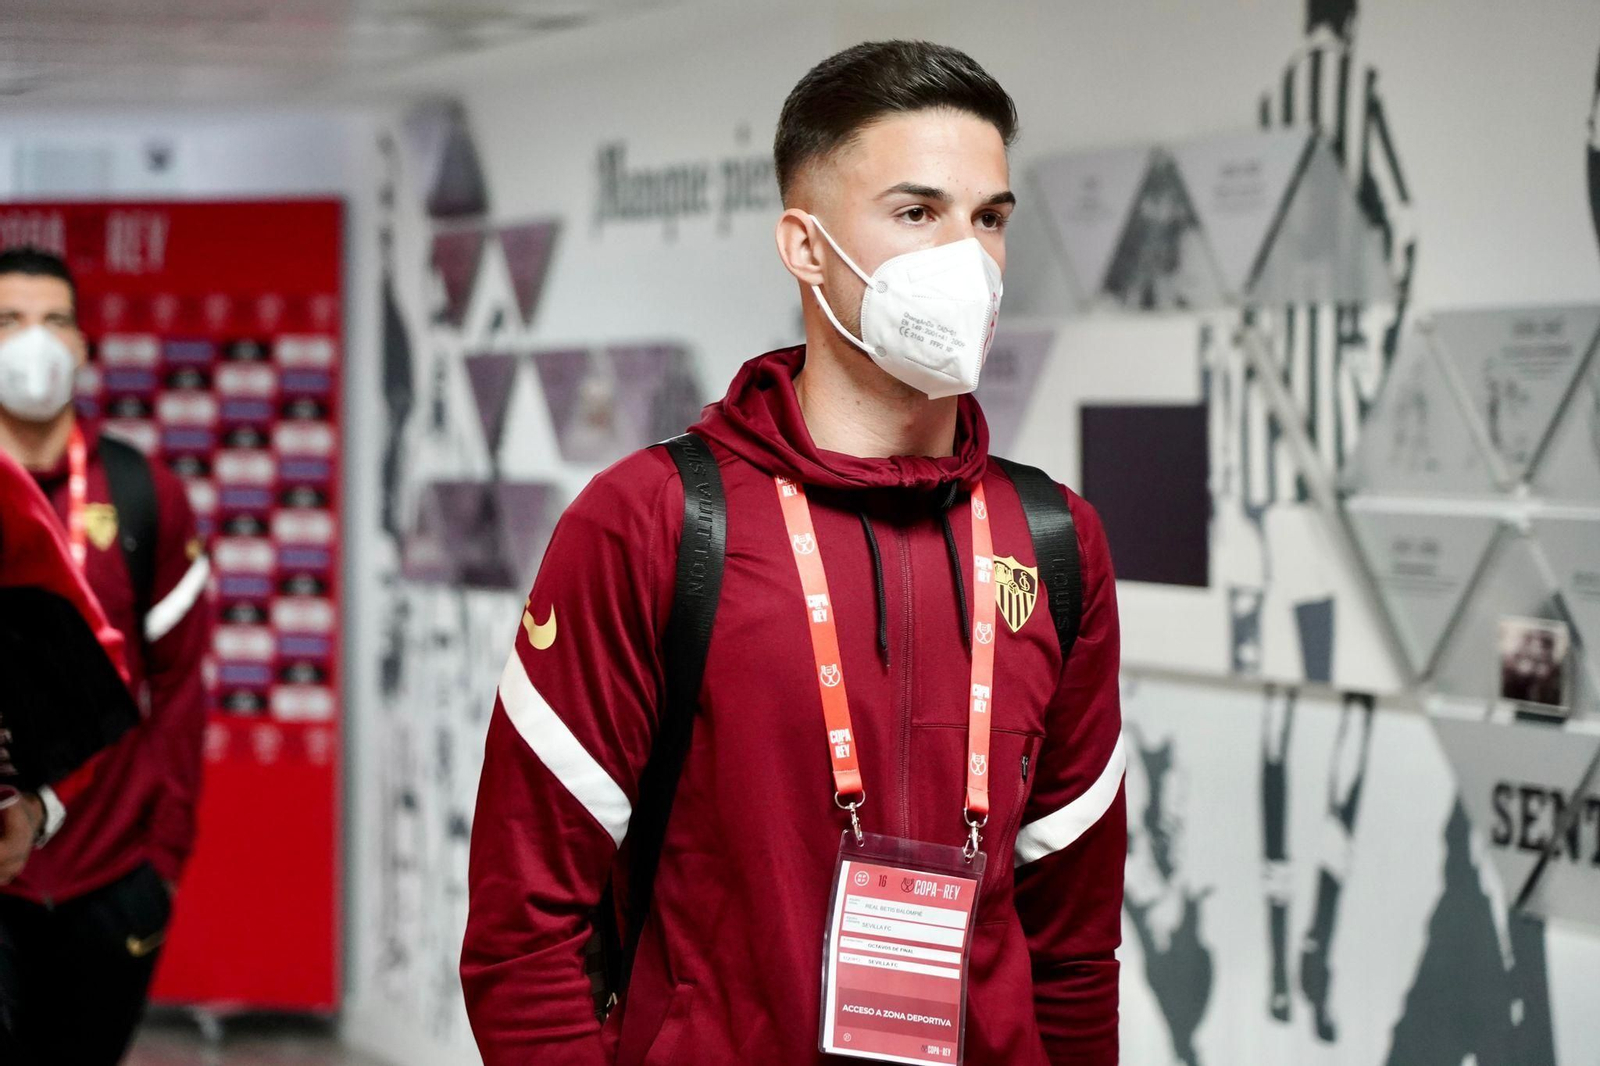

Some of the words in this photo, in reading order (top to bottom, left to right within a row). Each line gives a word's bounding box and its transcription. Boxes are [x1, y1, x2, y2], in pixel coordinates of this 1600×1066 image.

[829, 728, 851, 744] COPA
[834, 744, 850, 759] REY
[878, 874, 888, 888] 16
[914, 879, 938, 898] COPA
[943, 884, 961, 901] REY
[865, 903, 878, 912] REAL
[880, 905, 896, 914] BETIS
[862, 922, 883, 931] SEVILLA
[884, 924, 892, 932] FC
[867, 942, 891, 952] OCTAVOS
[900, 946, 914, 954] FINAL
[868, 958, 890, 967] SEVILLA
[842, 1004, 874, 1016] ACCESO
[875, 1009, 883, 1017] A
[883, 1009, 906, 1020] ZONA
[907, 1012, 952, 1028] DEPORTIVA
